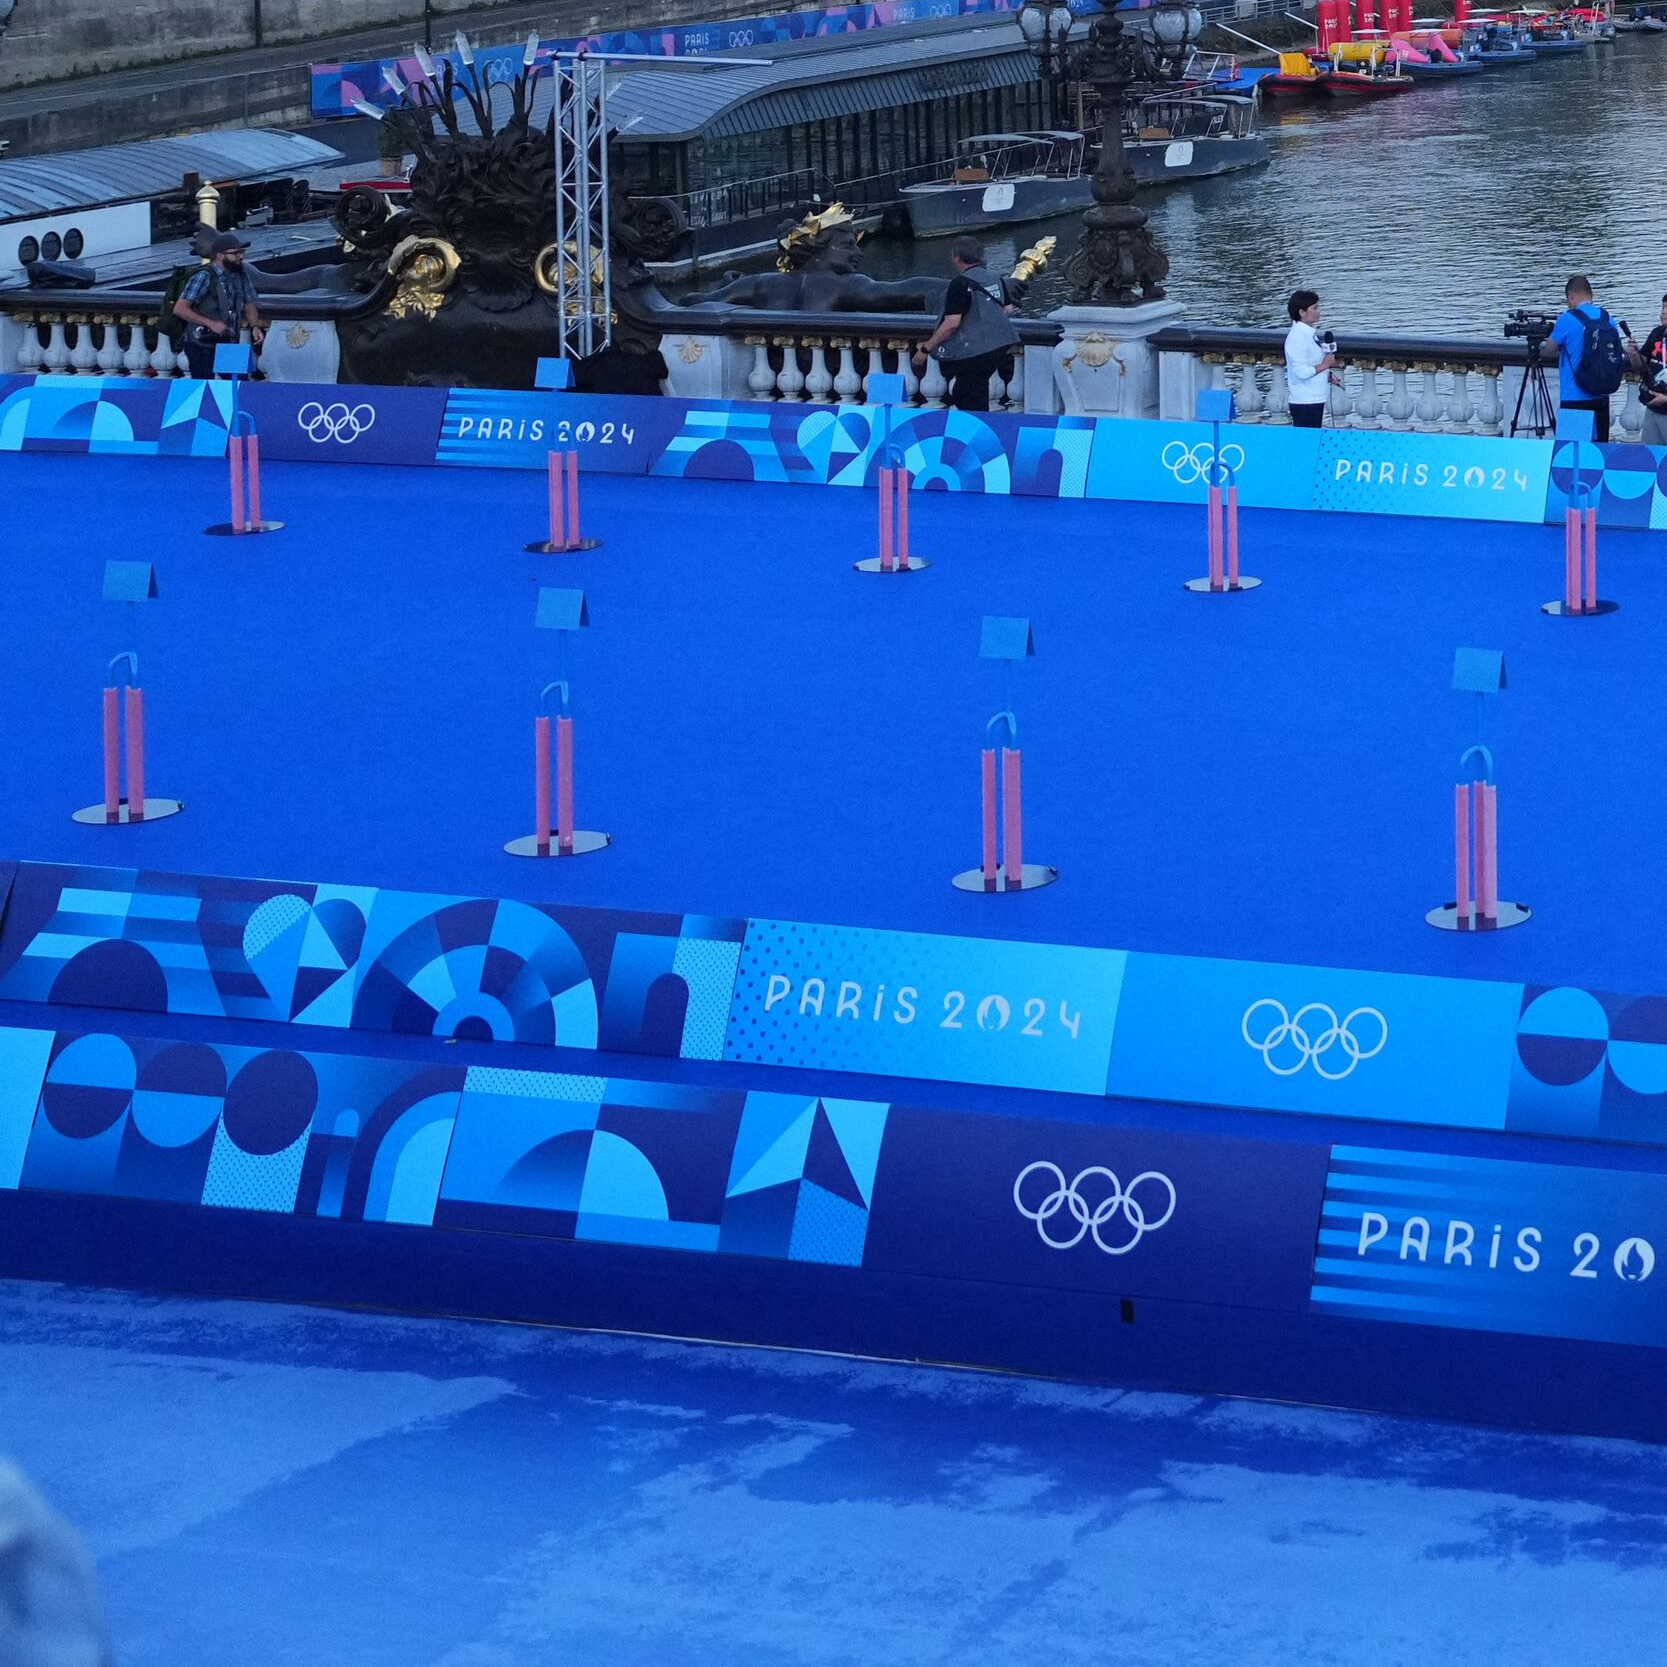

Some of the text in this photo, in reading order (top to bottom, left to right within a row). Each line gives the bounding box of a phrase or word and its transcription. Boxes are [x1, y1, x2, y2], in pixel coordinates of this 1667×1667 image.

[557, 420, 636, 446] 2024
[1442, 465, 1528, 492] 2024
[940, 990, 1082, 1040] 2024
